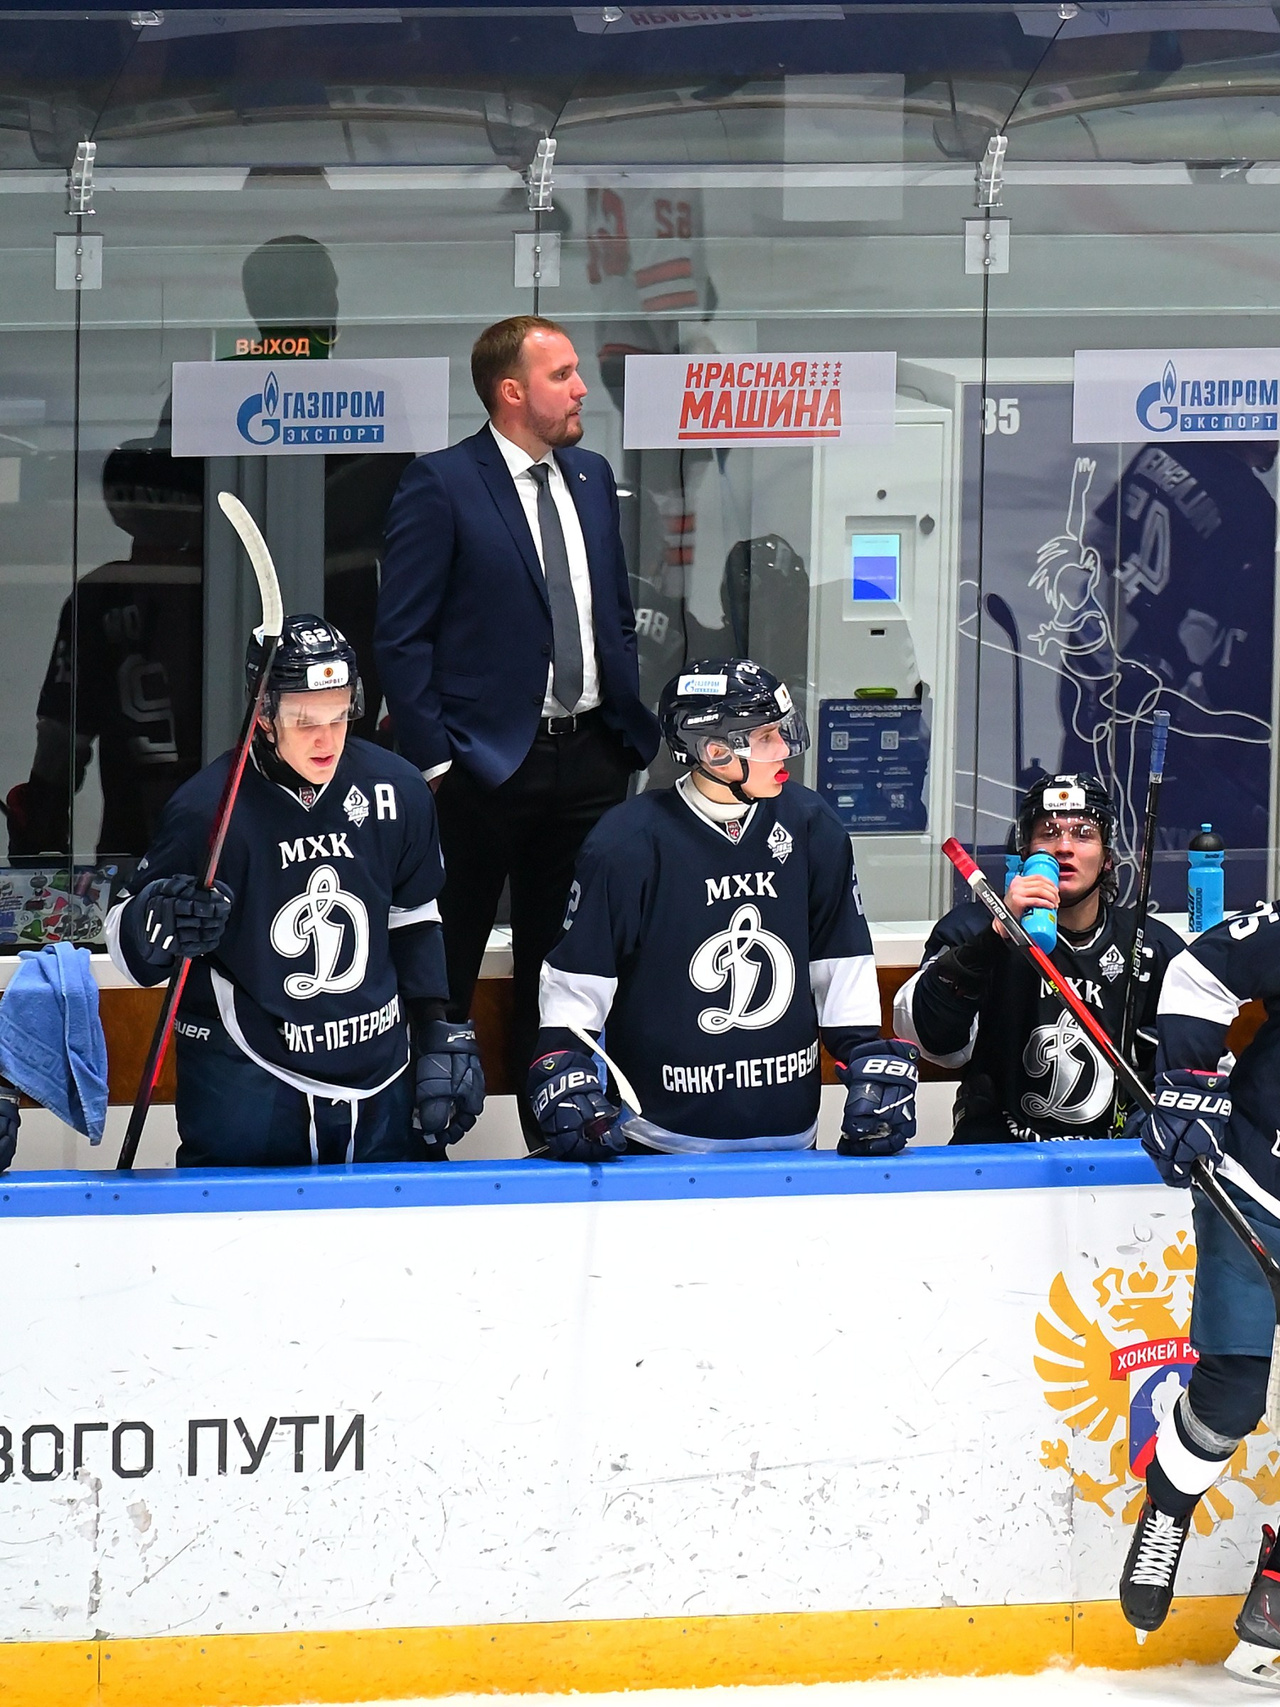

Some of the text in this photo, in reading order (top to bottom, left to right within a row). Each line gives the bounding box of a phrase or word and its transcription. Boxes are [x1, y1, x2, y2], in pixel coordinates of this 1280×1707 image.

[235, 337, 310, 357] ВЫХОД
[685, 361, 808, 388] КРАСНАЯ
[283, 391, 384, 419] ГАЗПРОМ
[1180, 379, 1279, 407] ГАЗПРОМ
[678, 389, 842, 429] МАШИНА
[1183, 414, 1274, 430] ЭКСПОРТ
[287, 427, 380, 442] ЭКСПОРТ
[300, 627, 332, 646] 62
[374, 783, 397, 820] A
[278, 832, 355, 870] МХК
[704, 871, 778, 906] МХК
[1117, 1340, 1178, 1371] ХОККЕЙ
[187, 1413, 364, 1477] ПУТИ
